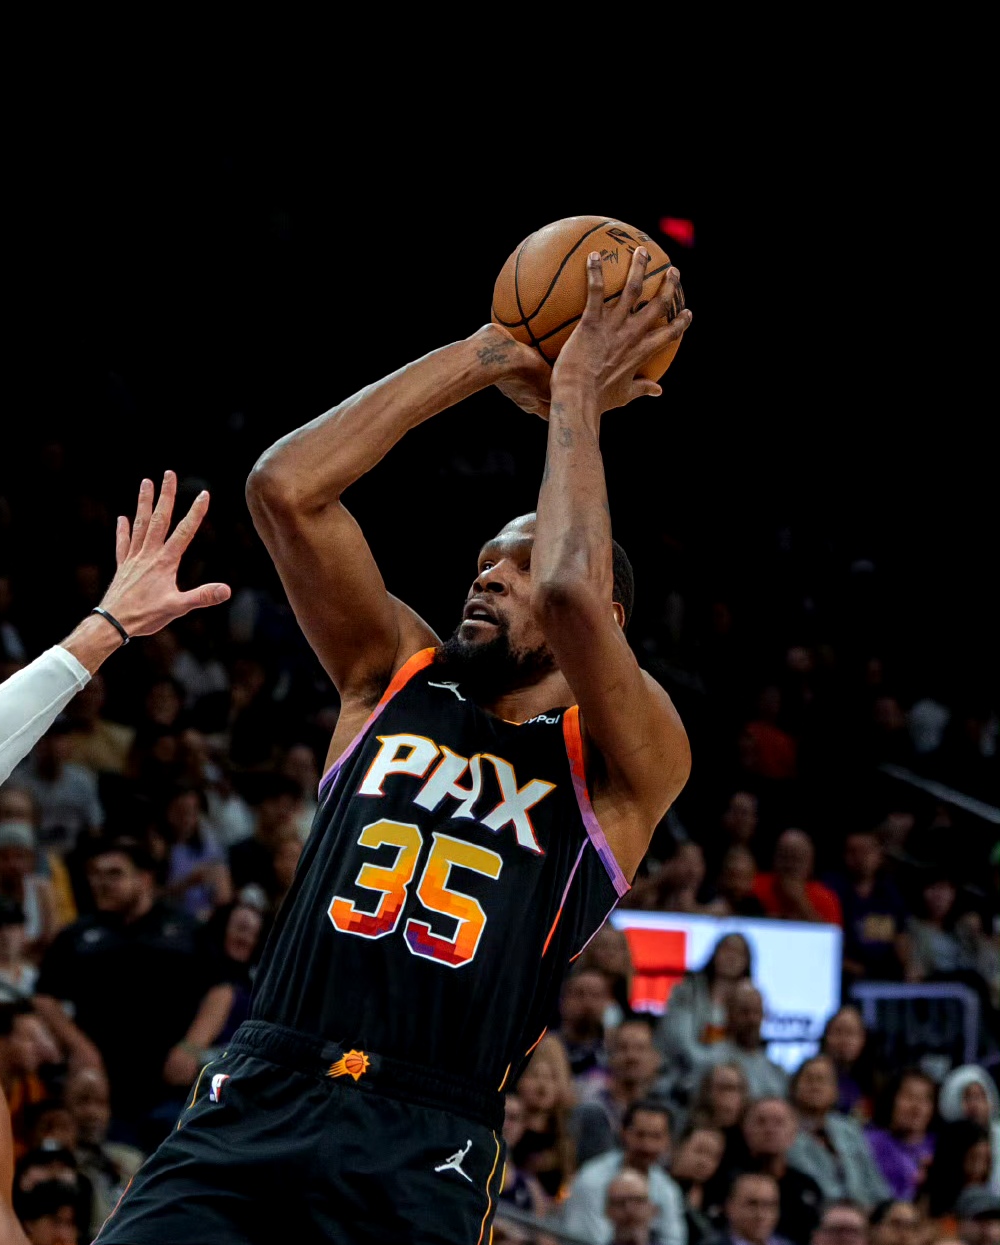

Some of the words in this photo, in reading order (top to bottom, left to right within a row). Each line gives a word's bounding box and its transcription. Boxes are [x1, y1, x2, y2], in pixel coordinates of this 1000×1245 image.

[523, 714, 560, 725] yPal
[358, 734, 556, 854] PHX
[328, 819, 503, 968] 35
